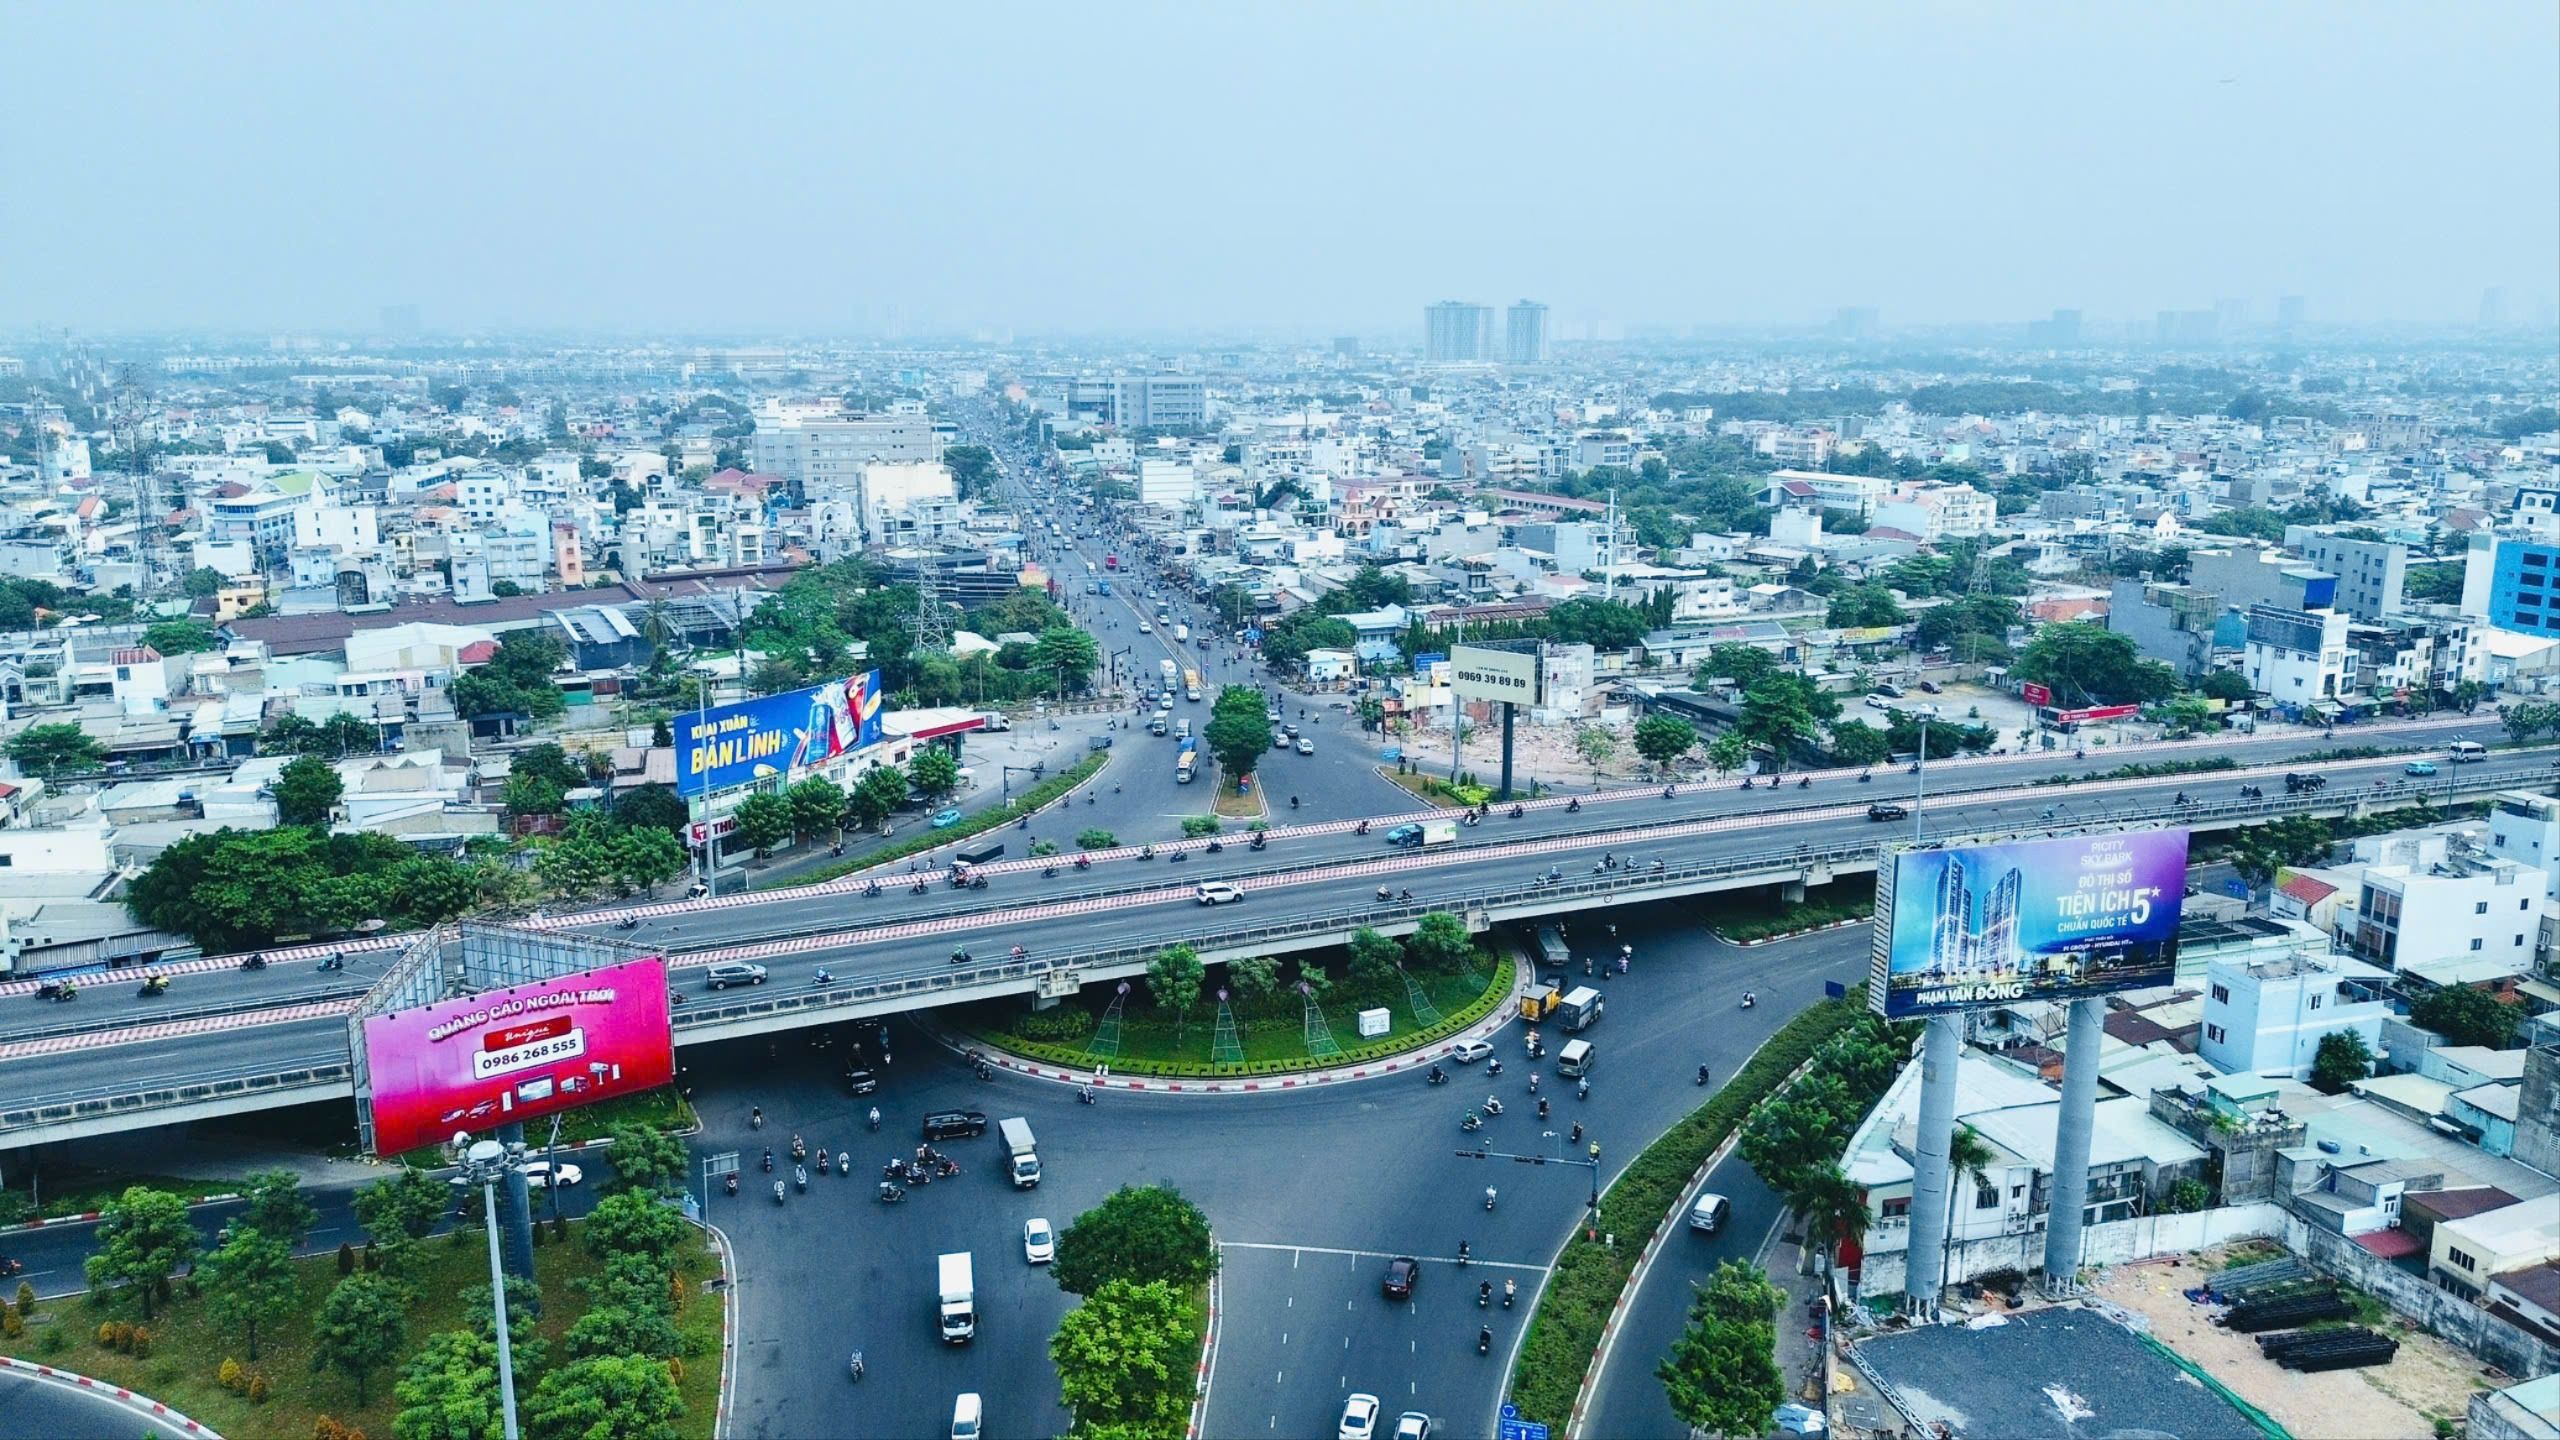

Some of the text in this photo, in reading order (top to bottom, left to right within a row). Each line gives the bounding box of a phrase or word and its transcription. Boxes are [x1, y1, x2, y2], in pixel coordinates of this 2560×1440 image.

[1458, 671, 1526, 688] 0969 39 89 89
[691, 729, 781, 775] BẢN LĨNH
[2091, 840, 2125, 853] PICITY
[2081, 855, 2103, 865] SKY
[2097, 873, 2114, 887] THỊ
[2117, 867, 2133, 884] SỐ
[2057, 889, 2096, 917] TIỆN
[2101, 887, 2130, 912] ÍCH
[2058, 912, 2129, 932] CHUẨN QUỐC TẾ
[489, 999, 525, 1020] CÁO
[527, 989, 576, 1011] NGOÀI
[577, 987, 616, 1005] TRỜI
[1917, 991, 1947, 1007] PHẠM
[1948, 986, 1973, 1002] VĂN
[482, 1038, 577, 1070] 0986 268 555
